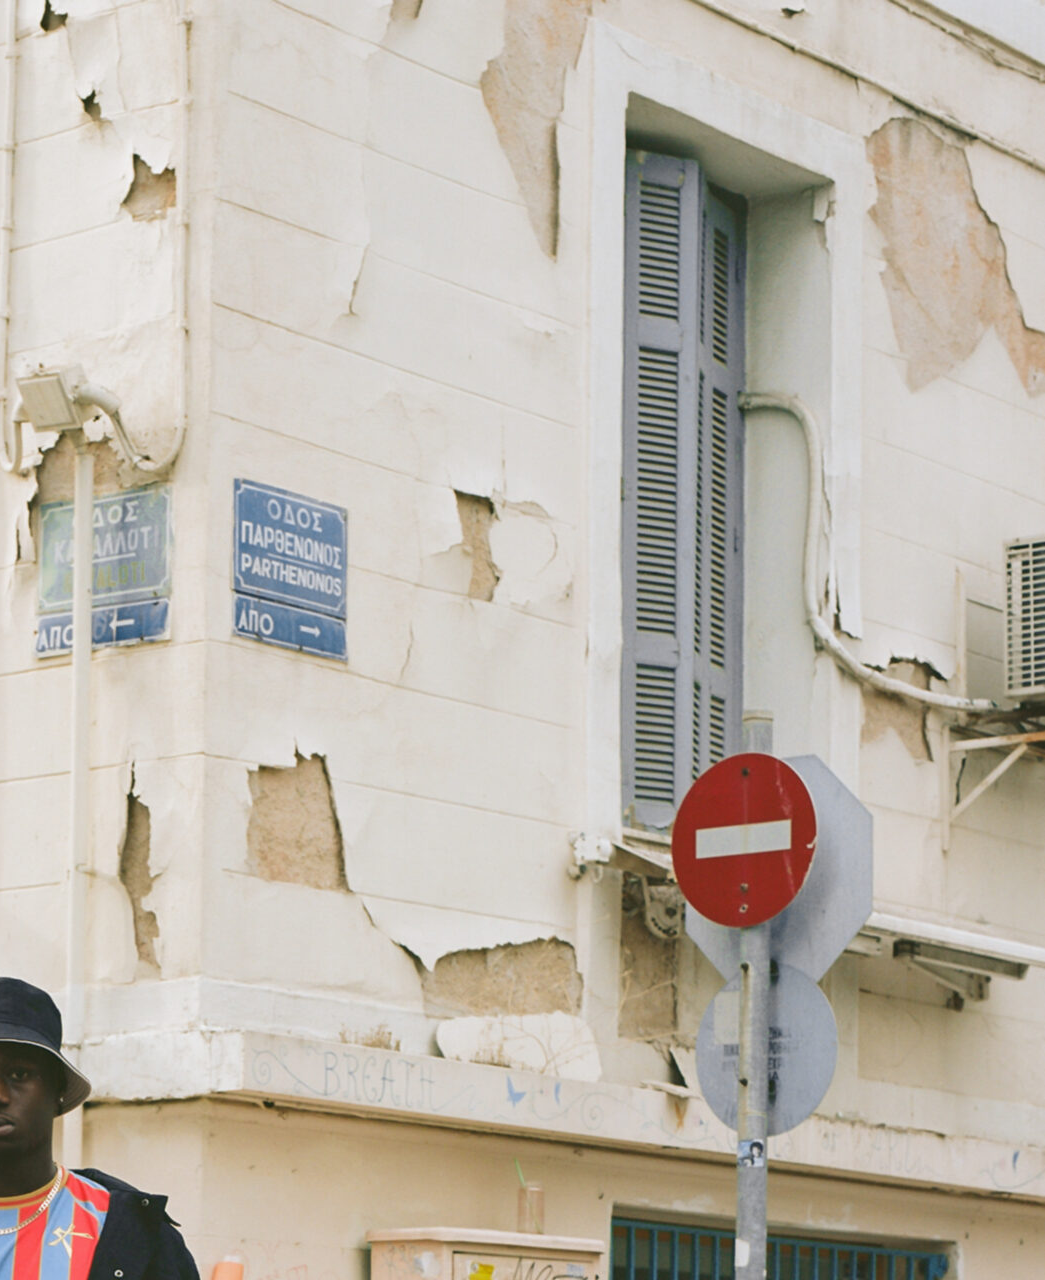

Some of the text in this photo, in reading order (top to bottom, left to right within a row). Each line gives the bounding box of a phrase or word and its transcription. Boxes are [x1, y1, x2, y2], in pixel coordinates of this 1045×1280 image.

[72, 501, 140, 528] ΔΟΣ
[267, 499, 323, 533] ΟΔΟΣ
[241, 520, 343, 571] ΠΑΡΘΕΝΩΝΟΣ
[241, 553, 343, 597] PARTHENONOS
[238, 607, 274, 636] ΑΠΟ
